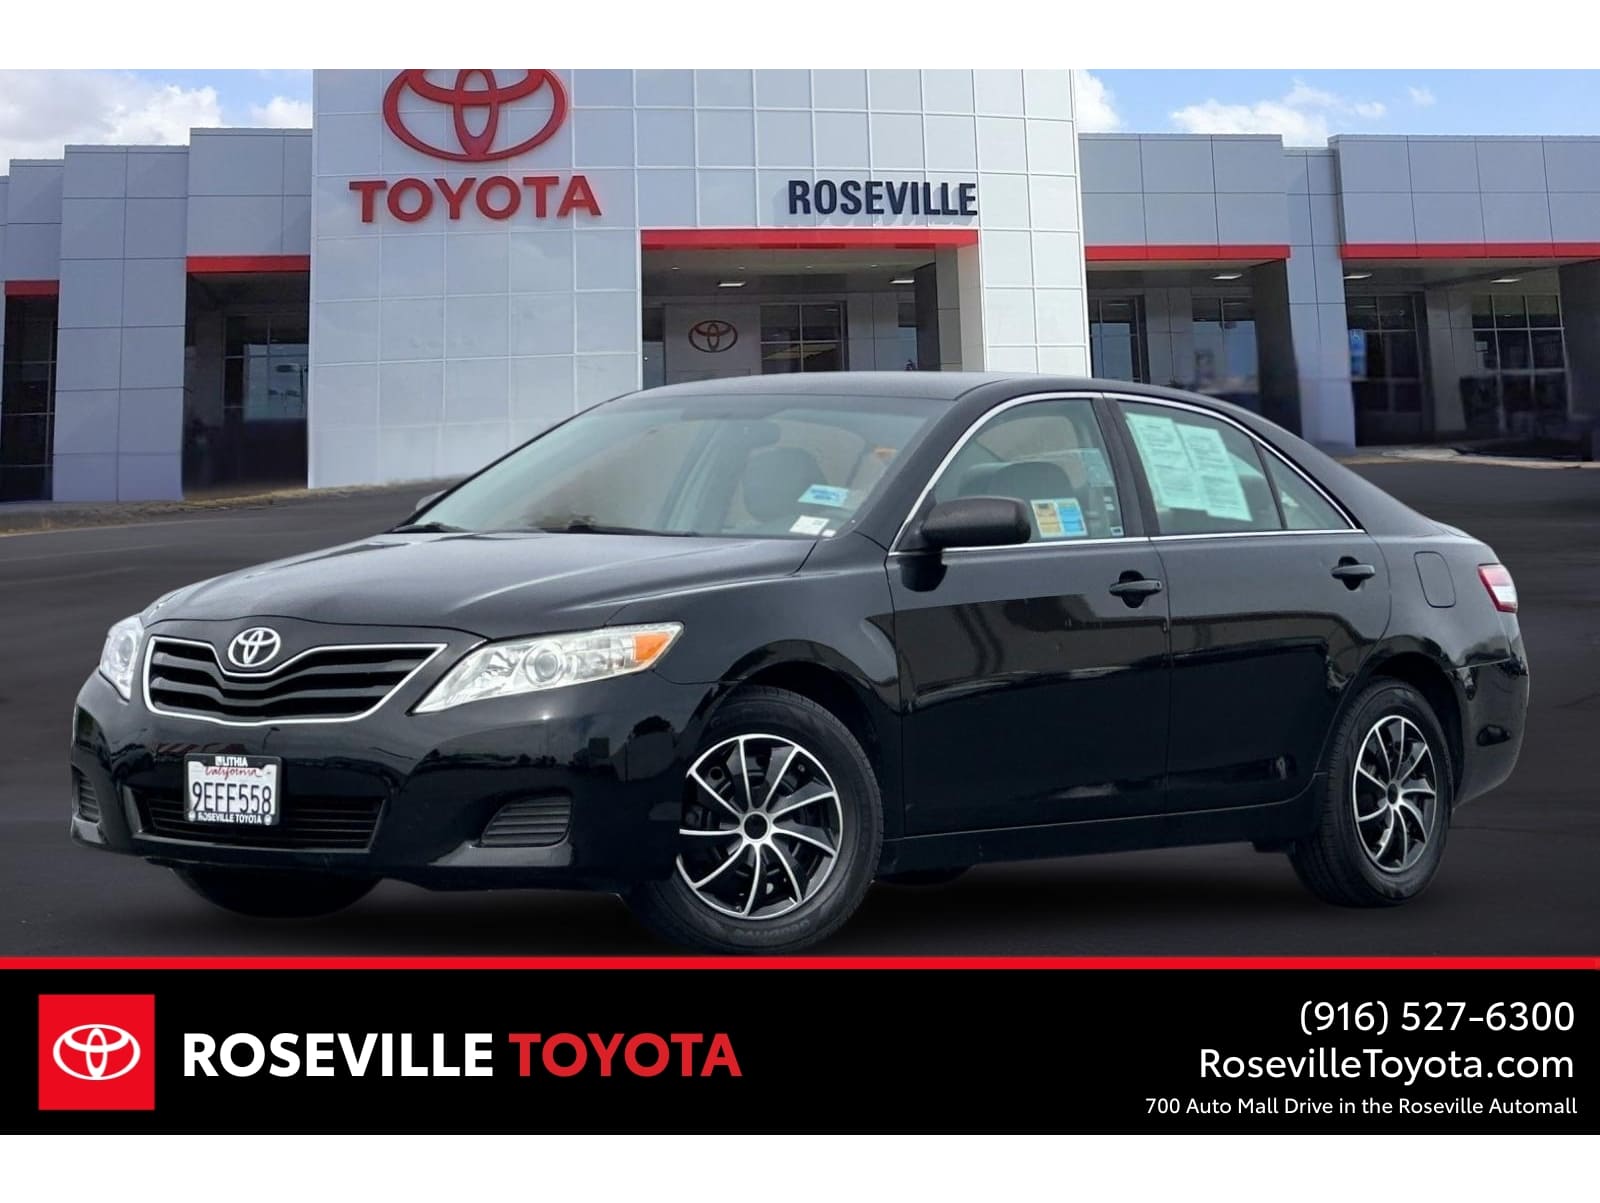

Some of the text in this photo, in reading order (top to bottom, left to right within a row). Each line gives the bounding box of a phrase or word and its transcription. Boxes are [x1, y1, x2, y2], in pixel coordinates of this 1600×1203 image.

[349, 175, 602, 223] TOYOTA
[788, 179, 979, 217] ROSEVILLE
[224, 756, 248, 766] LITHIA
[205, 767, 263, 780] California
[192, 781, 272, 814] 9EFF558
[198, 813, 263, 824] ROSEVILLE TOYOTA
